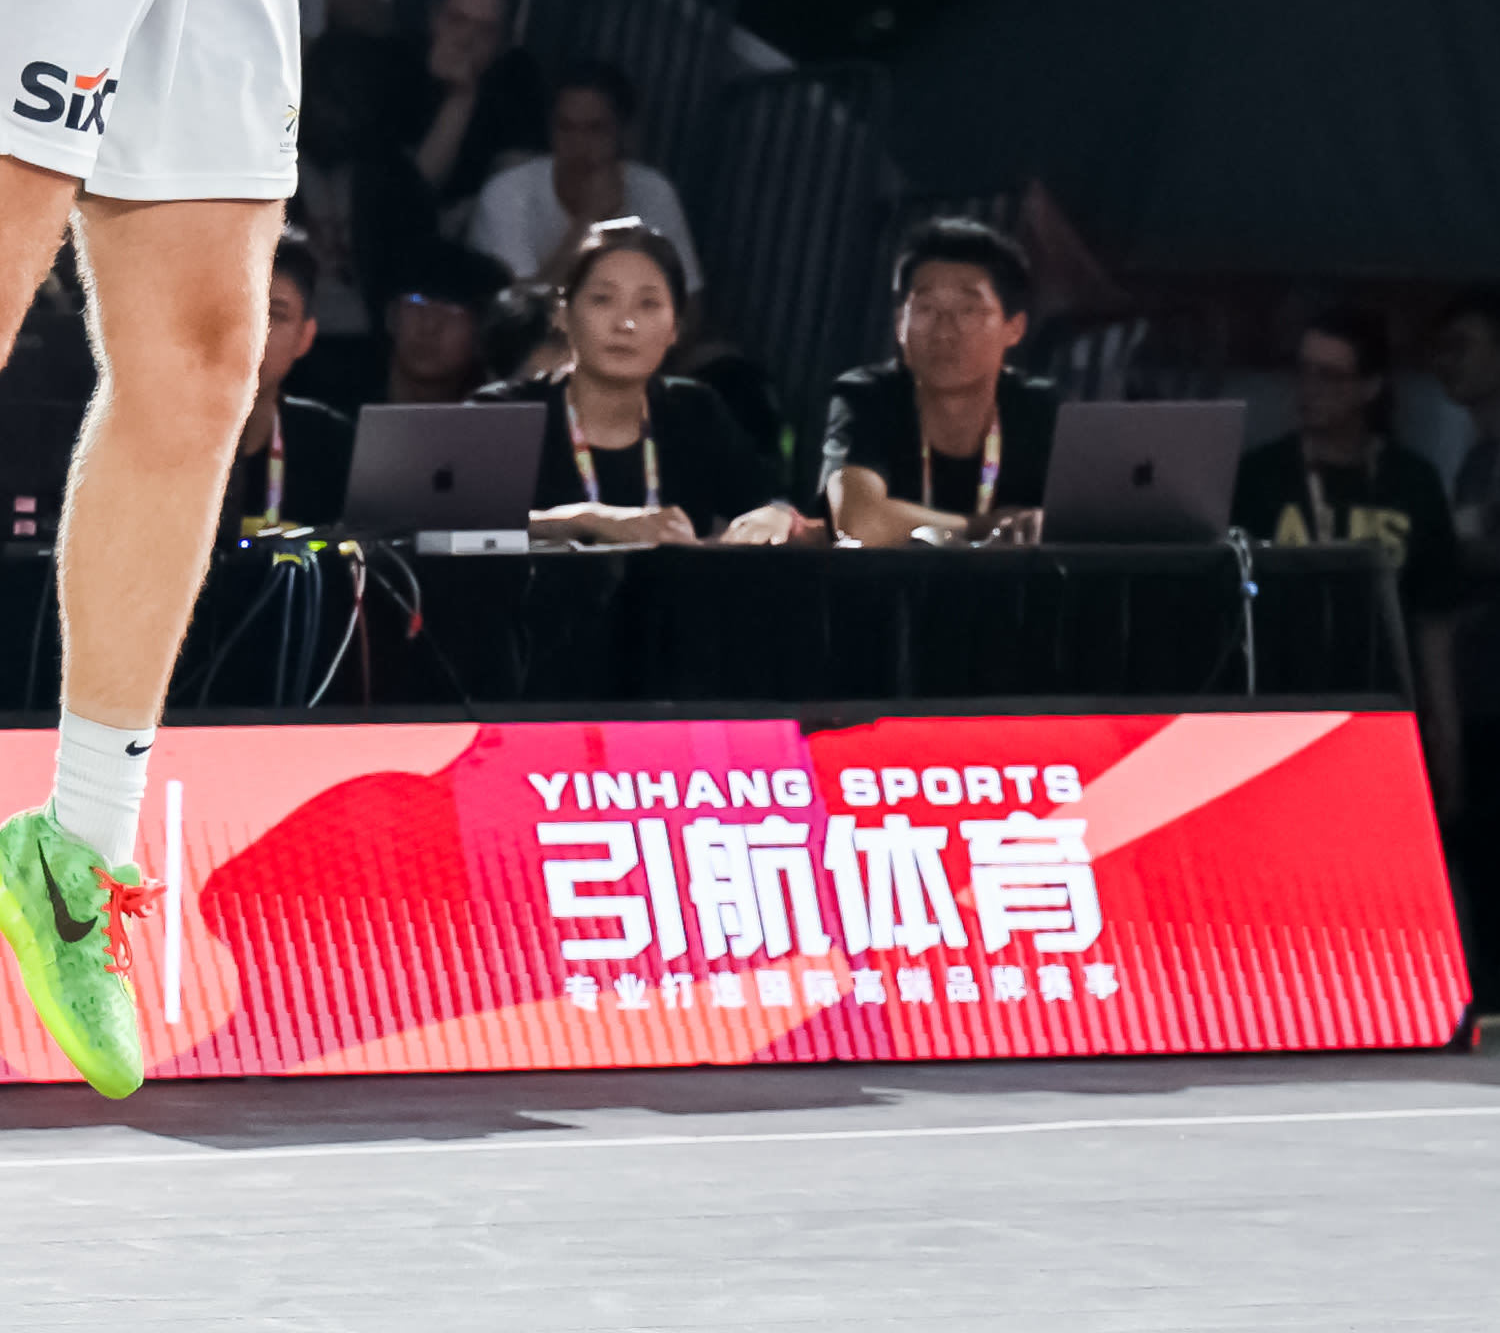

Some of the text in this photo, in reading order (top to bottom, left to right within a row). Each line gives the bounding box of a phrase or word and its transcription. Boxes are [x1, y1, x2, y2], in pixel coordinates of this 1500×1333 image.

[527, 765, 1083, 811] YINHANG SPORTS
[537, 811, 1104, 961] 引航体育
